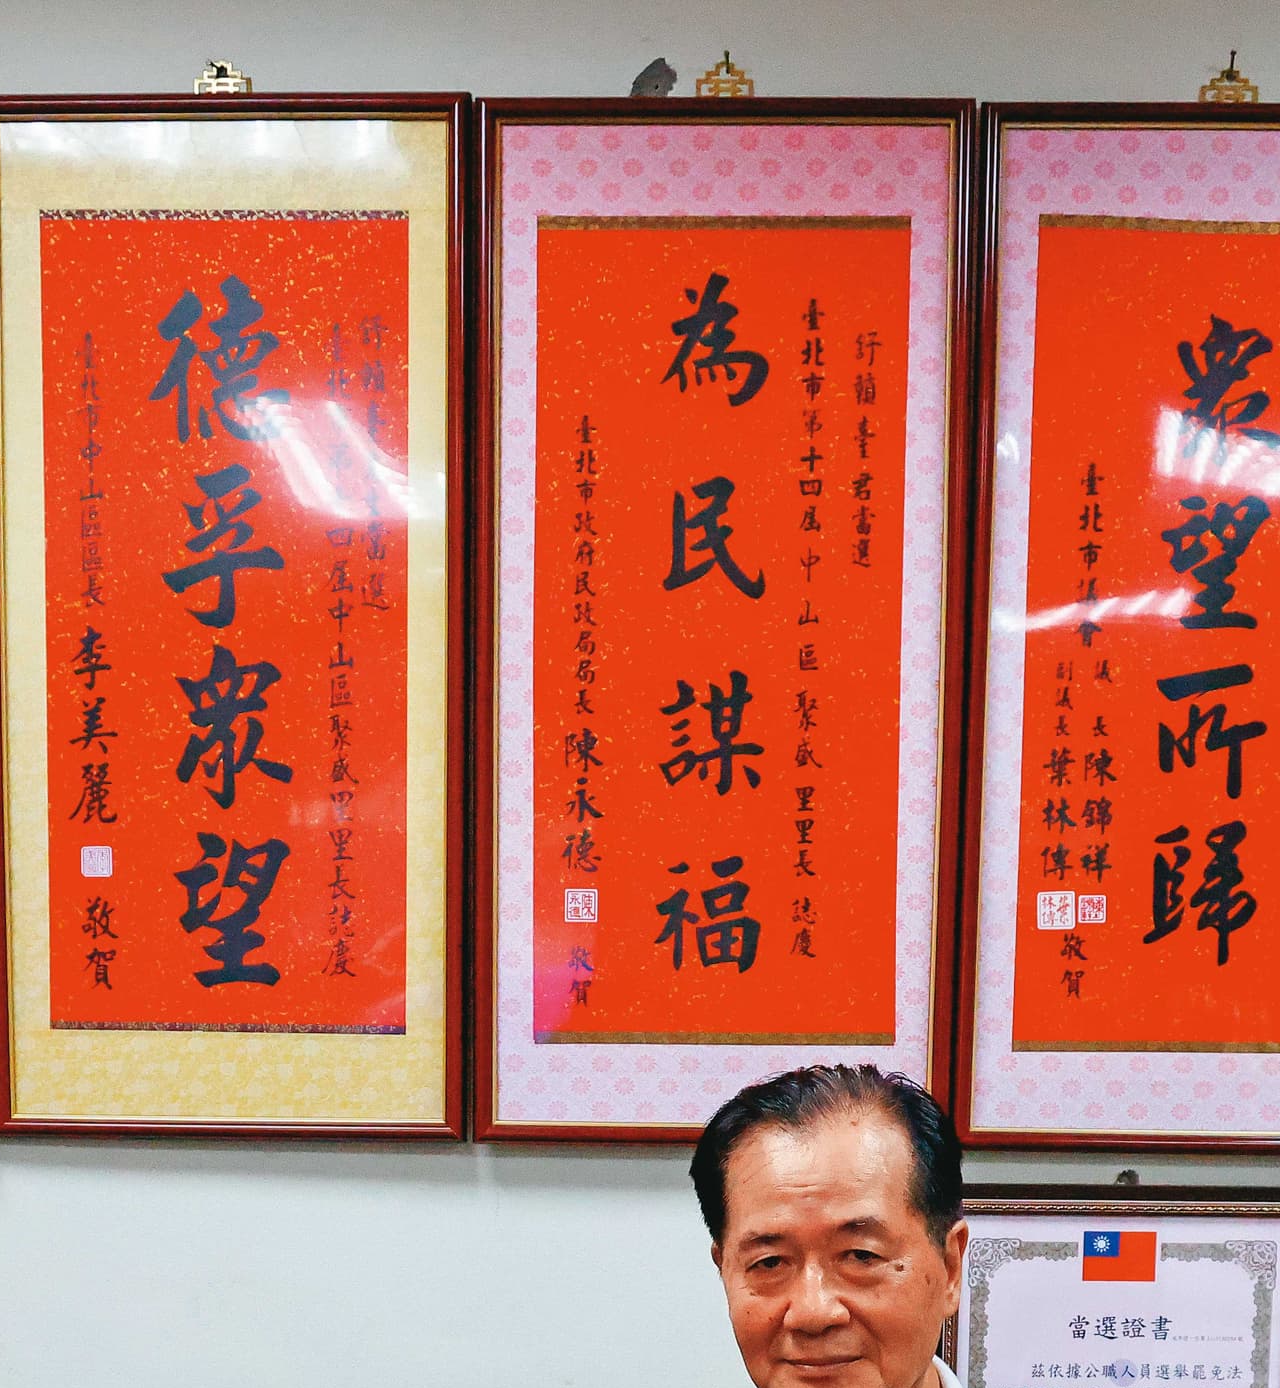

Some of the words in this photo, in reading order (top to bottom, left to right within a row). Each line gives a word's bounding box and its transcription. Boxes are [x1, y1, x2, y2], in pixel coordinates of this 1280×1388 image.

[654, 272, 769, 974] 為民謀福
[80, 896, 119, 991] 敬賀
[1060, 933, 1089, 1000] 敬賀
[1068, 1314, 1173, 1342] 當選證書
[1031, 1358, 1243, 1382] 茲依據公職人員選舉罷免法
